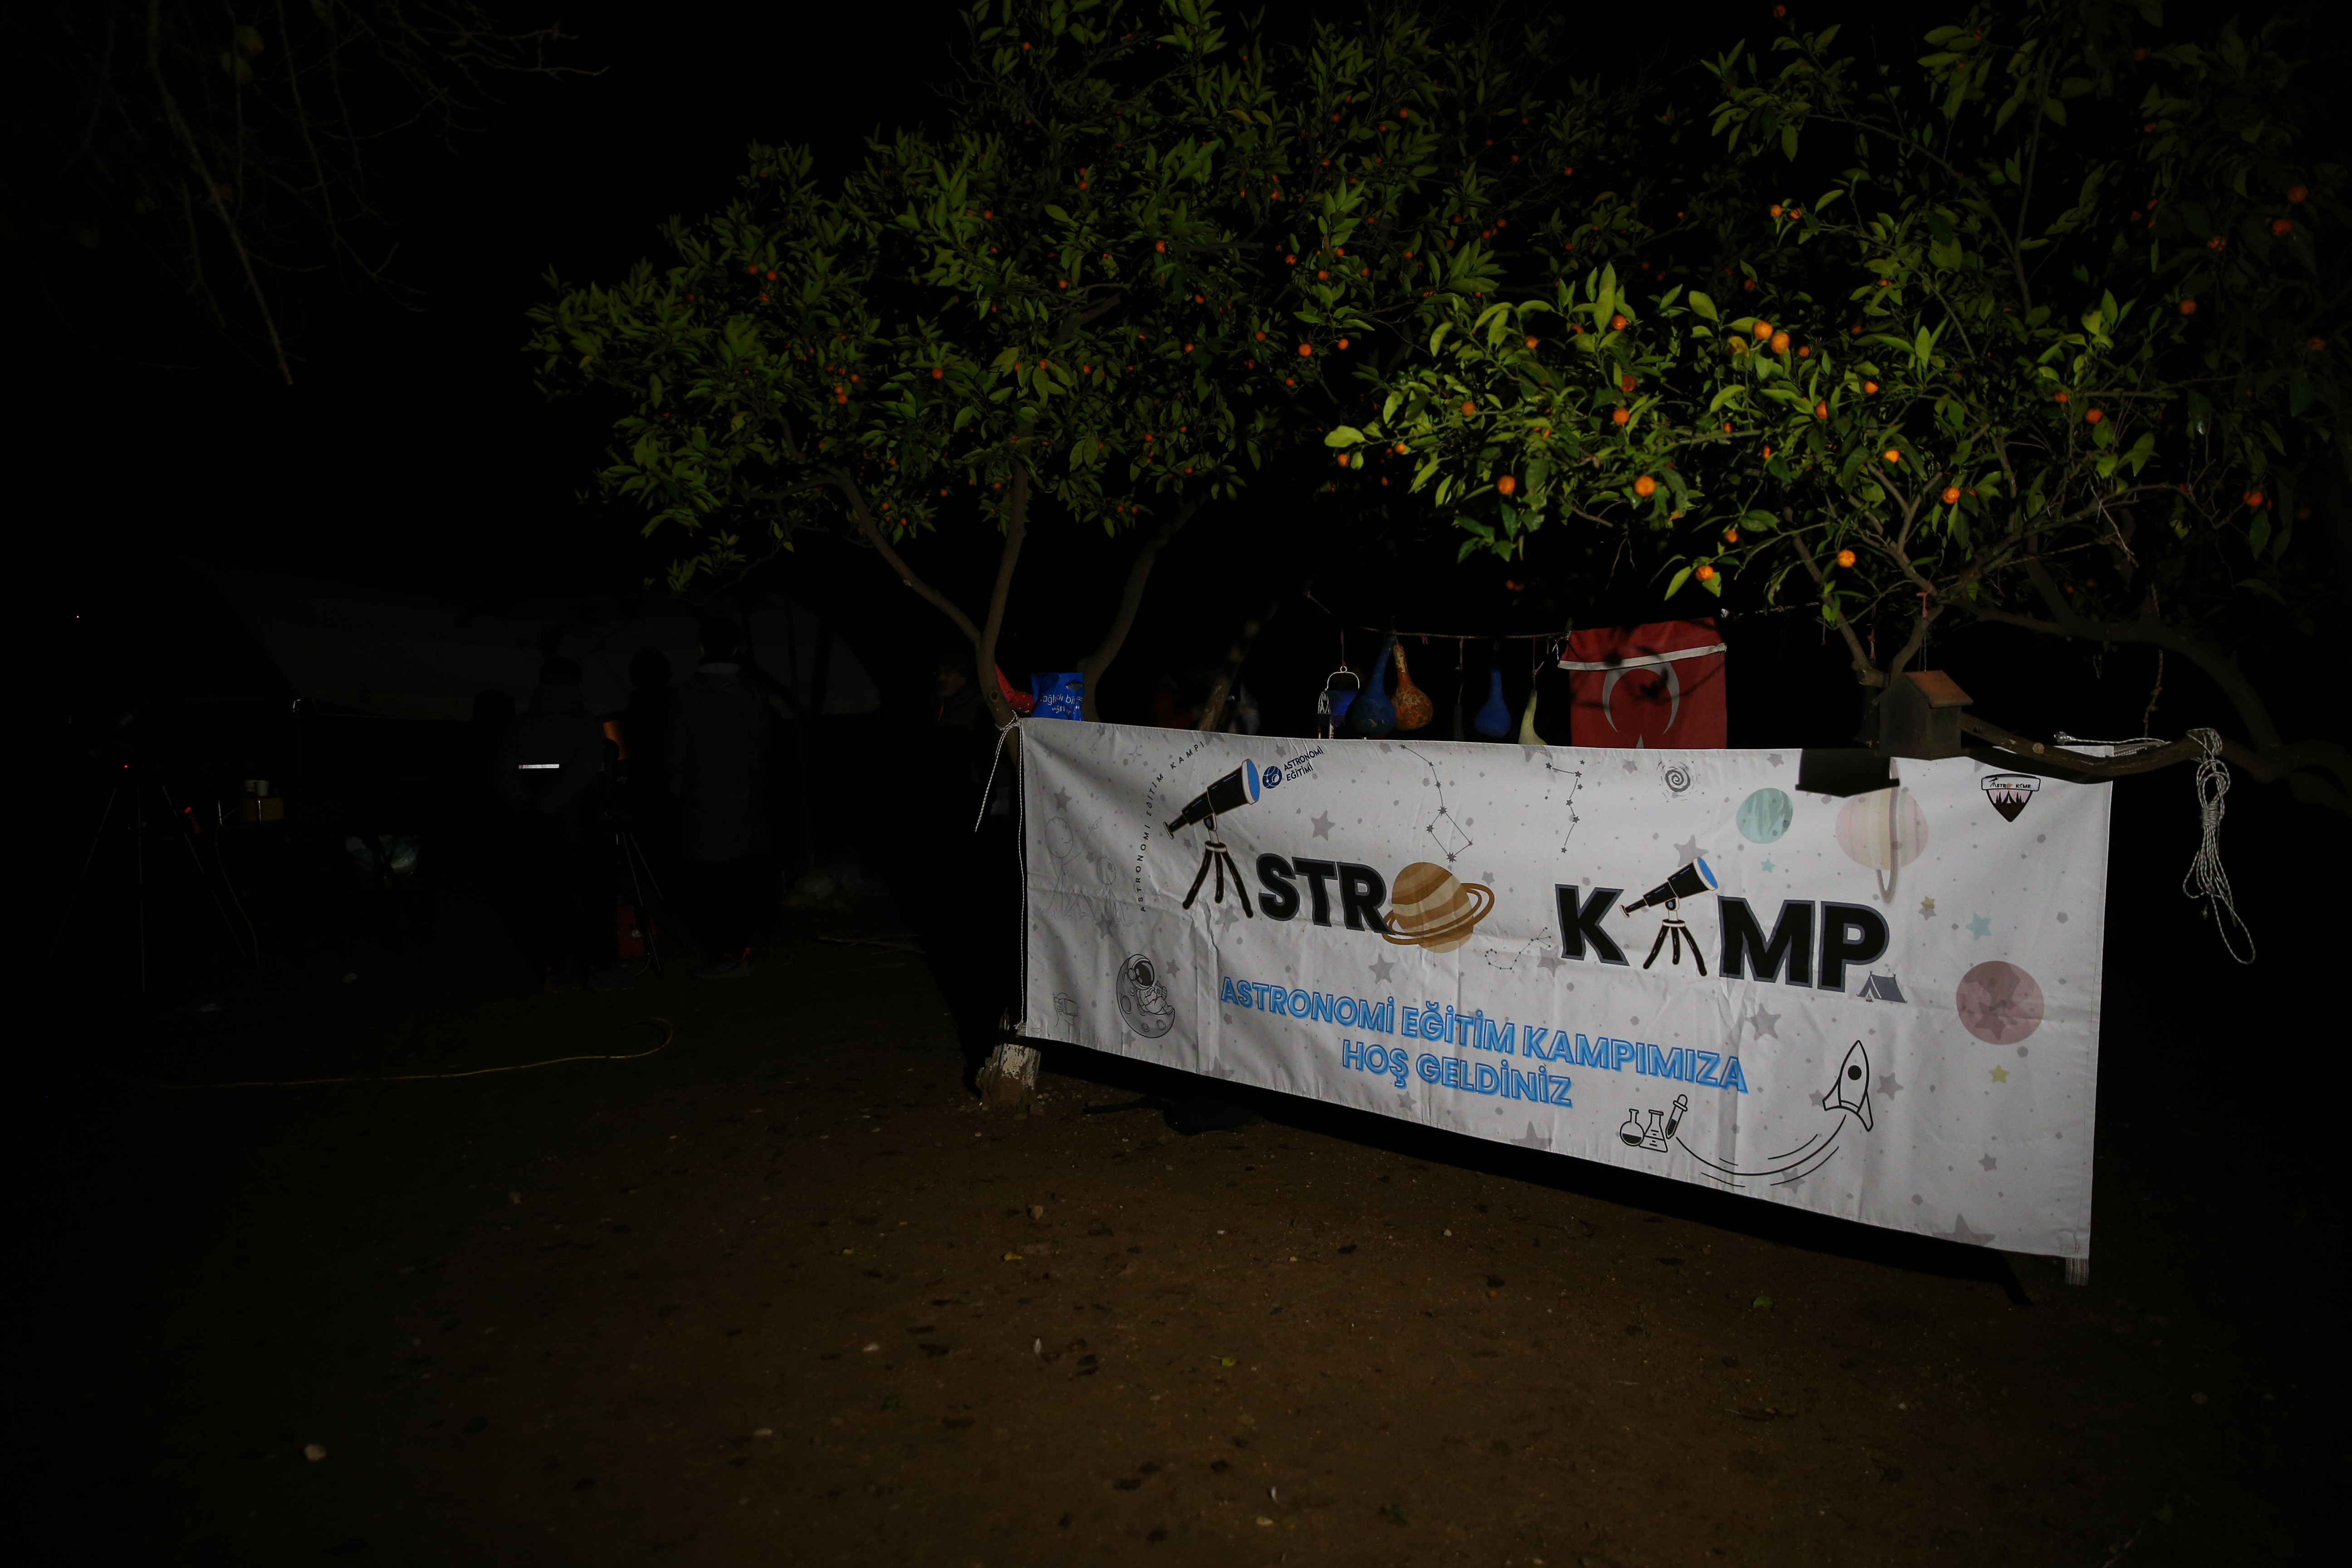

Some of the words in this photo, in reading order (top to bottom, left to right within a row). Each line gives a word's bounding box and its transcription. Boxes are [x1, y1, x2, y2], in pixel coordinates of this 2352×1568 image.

[1170, 740, 1205, 770] KAMPI
[1284, 745, 1324, 771] ASTRONOMİ
[1286, 762, 1314, 781] EĞİTİMİ
[1221, 976, 1395, 1035] ASTRONOMİ
[1401, 1000, 1515, 1055] EĞİTİM
[1522, 1025, 1749, 1094] KAMPIMIZA
[1342, 1039, 1409, 1088] HOŞ
[1416, 1053, 1573, 1108] GELDİNİZ
